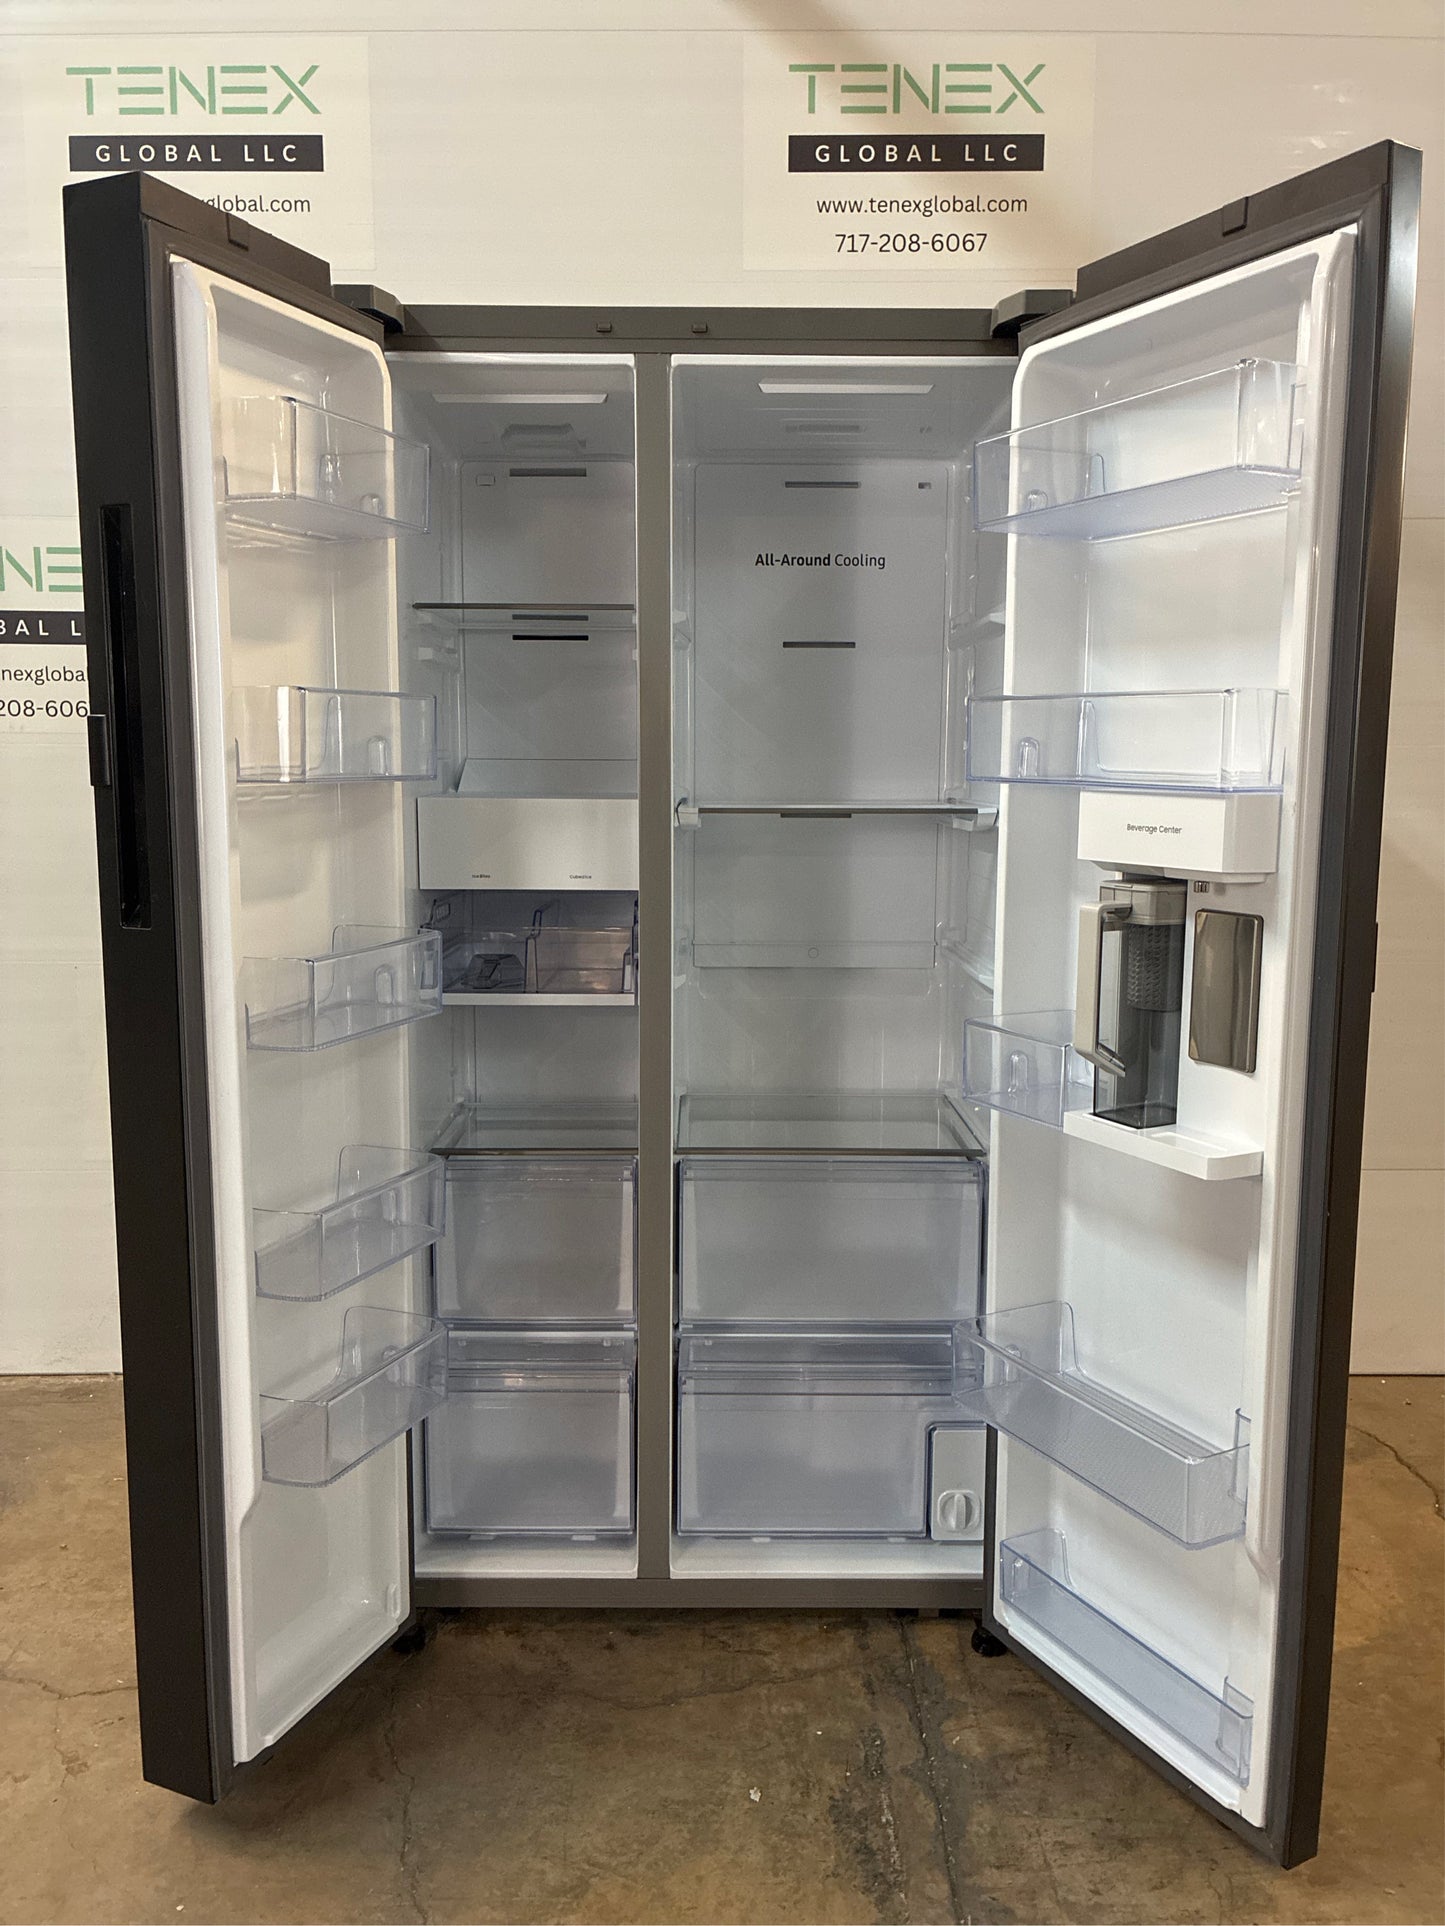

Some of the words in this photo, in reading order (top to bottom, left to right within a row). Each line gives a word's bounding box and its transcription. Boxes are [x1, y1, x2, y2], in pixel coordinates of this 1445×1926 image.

[66, 65, 321, 115] TENEX
[788, 63, 1046, 114] TENEX
[95, 144, 222, 163] GLOBAL
[243, 144, 298, 162] LLC
[814, 144, 942, 163] GLOBAL
[964, 143, 1018, 162] LLC
[201, 194, 311, 213] global.com
[816, 194, 1028, 218] www.tenexglobal.com
[835, 232, 988, 253] 717-208-6067
[754, 552, 831, 567] All-Around
[834, 553, 886, 570] Cooling
[1, 666, 88, 686] nexgloba
[1126, 823, 1158, 835] Beverage
[1158, 825, 1183, 834] Center
